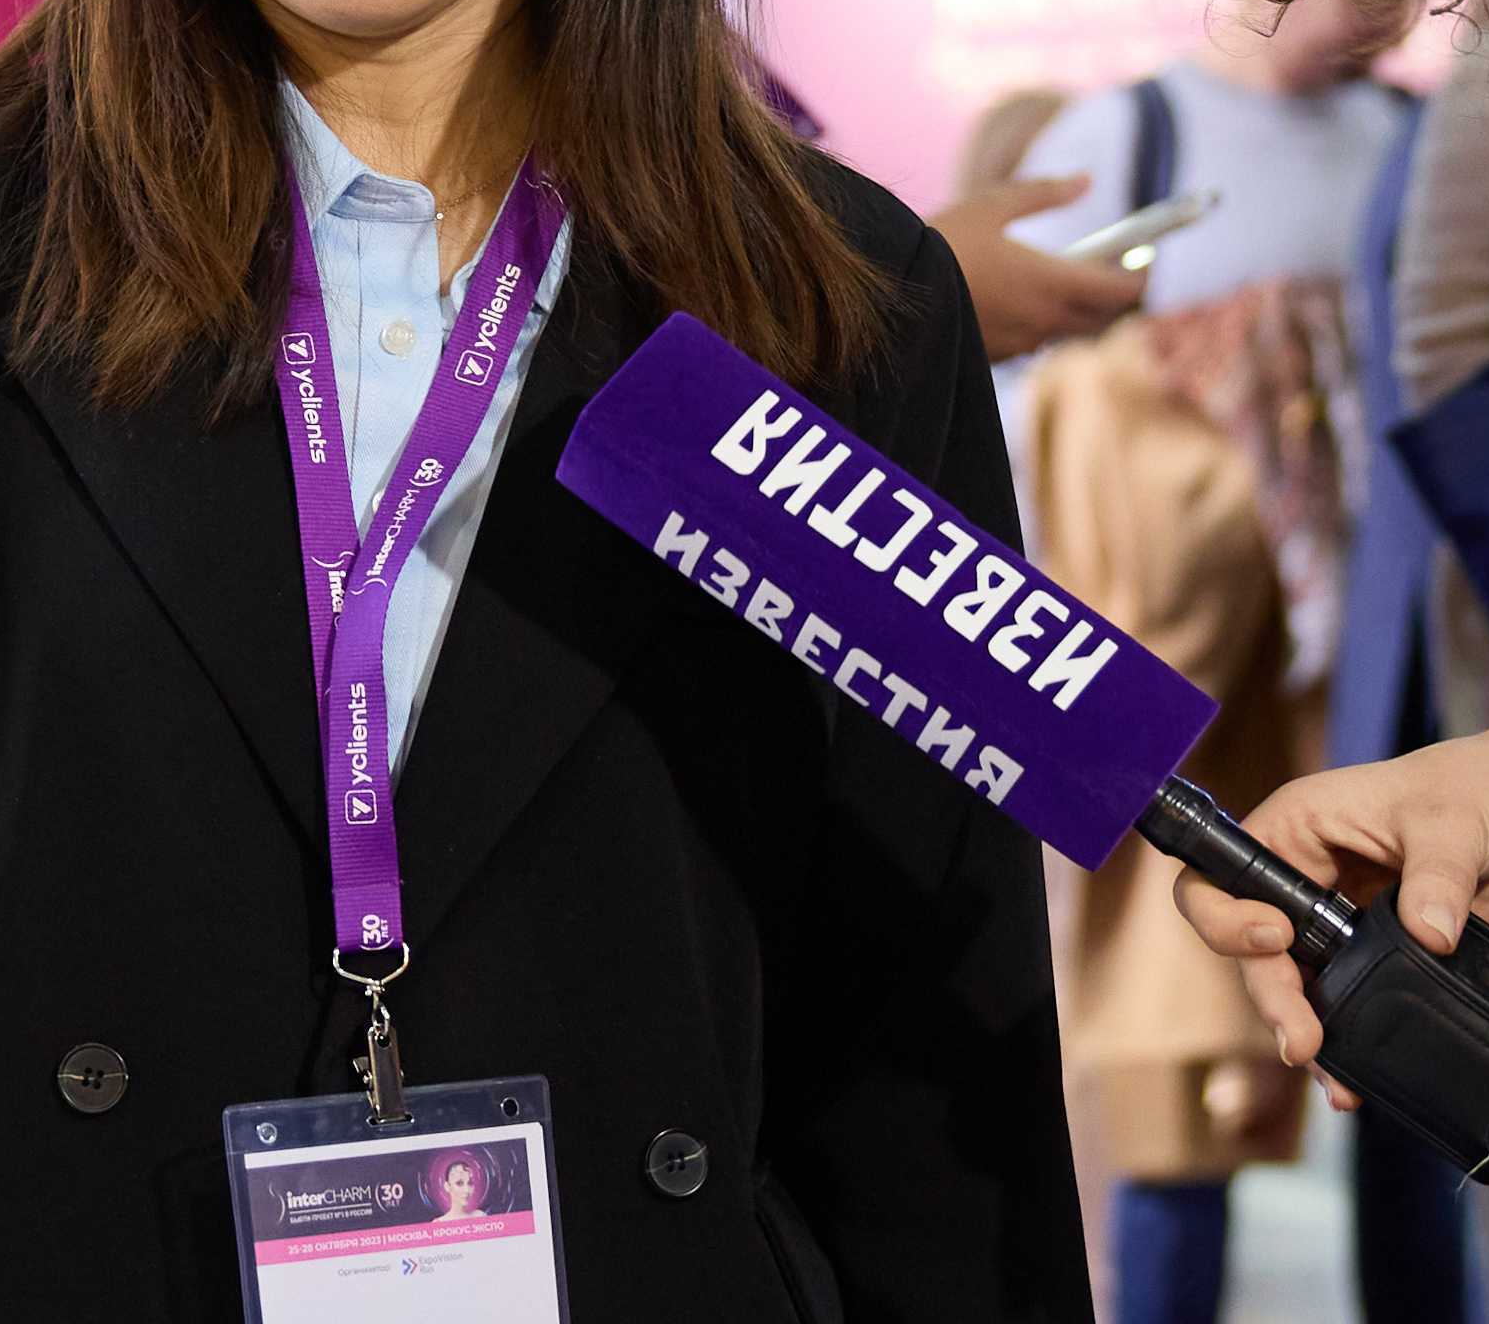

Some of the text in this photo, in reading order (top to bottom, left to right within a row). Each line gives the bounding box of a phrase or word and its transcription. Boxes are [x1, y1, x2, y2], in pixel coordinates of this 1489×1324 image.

[471, 262, 522, 353] yclients
[289, 367, 327, 465] yclients
[414, 458, 439, 481] 30
[711, 389, 1118, 712] ИЗВЕСТИЯ
[652, 510, 1024, 806] ИЗВЕСТИЯ
[349, 681, 368, 786] yclients
[362, 914, 382, 945] 30
[286, 1183, 404, 1209] interCHARM 30
